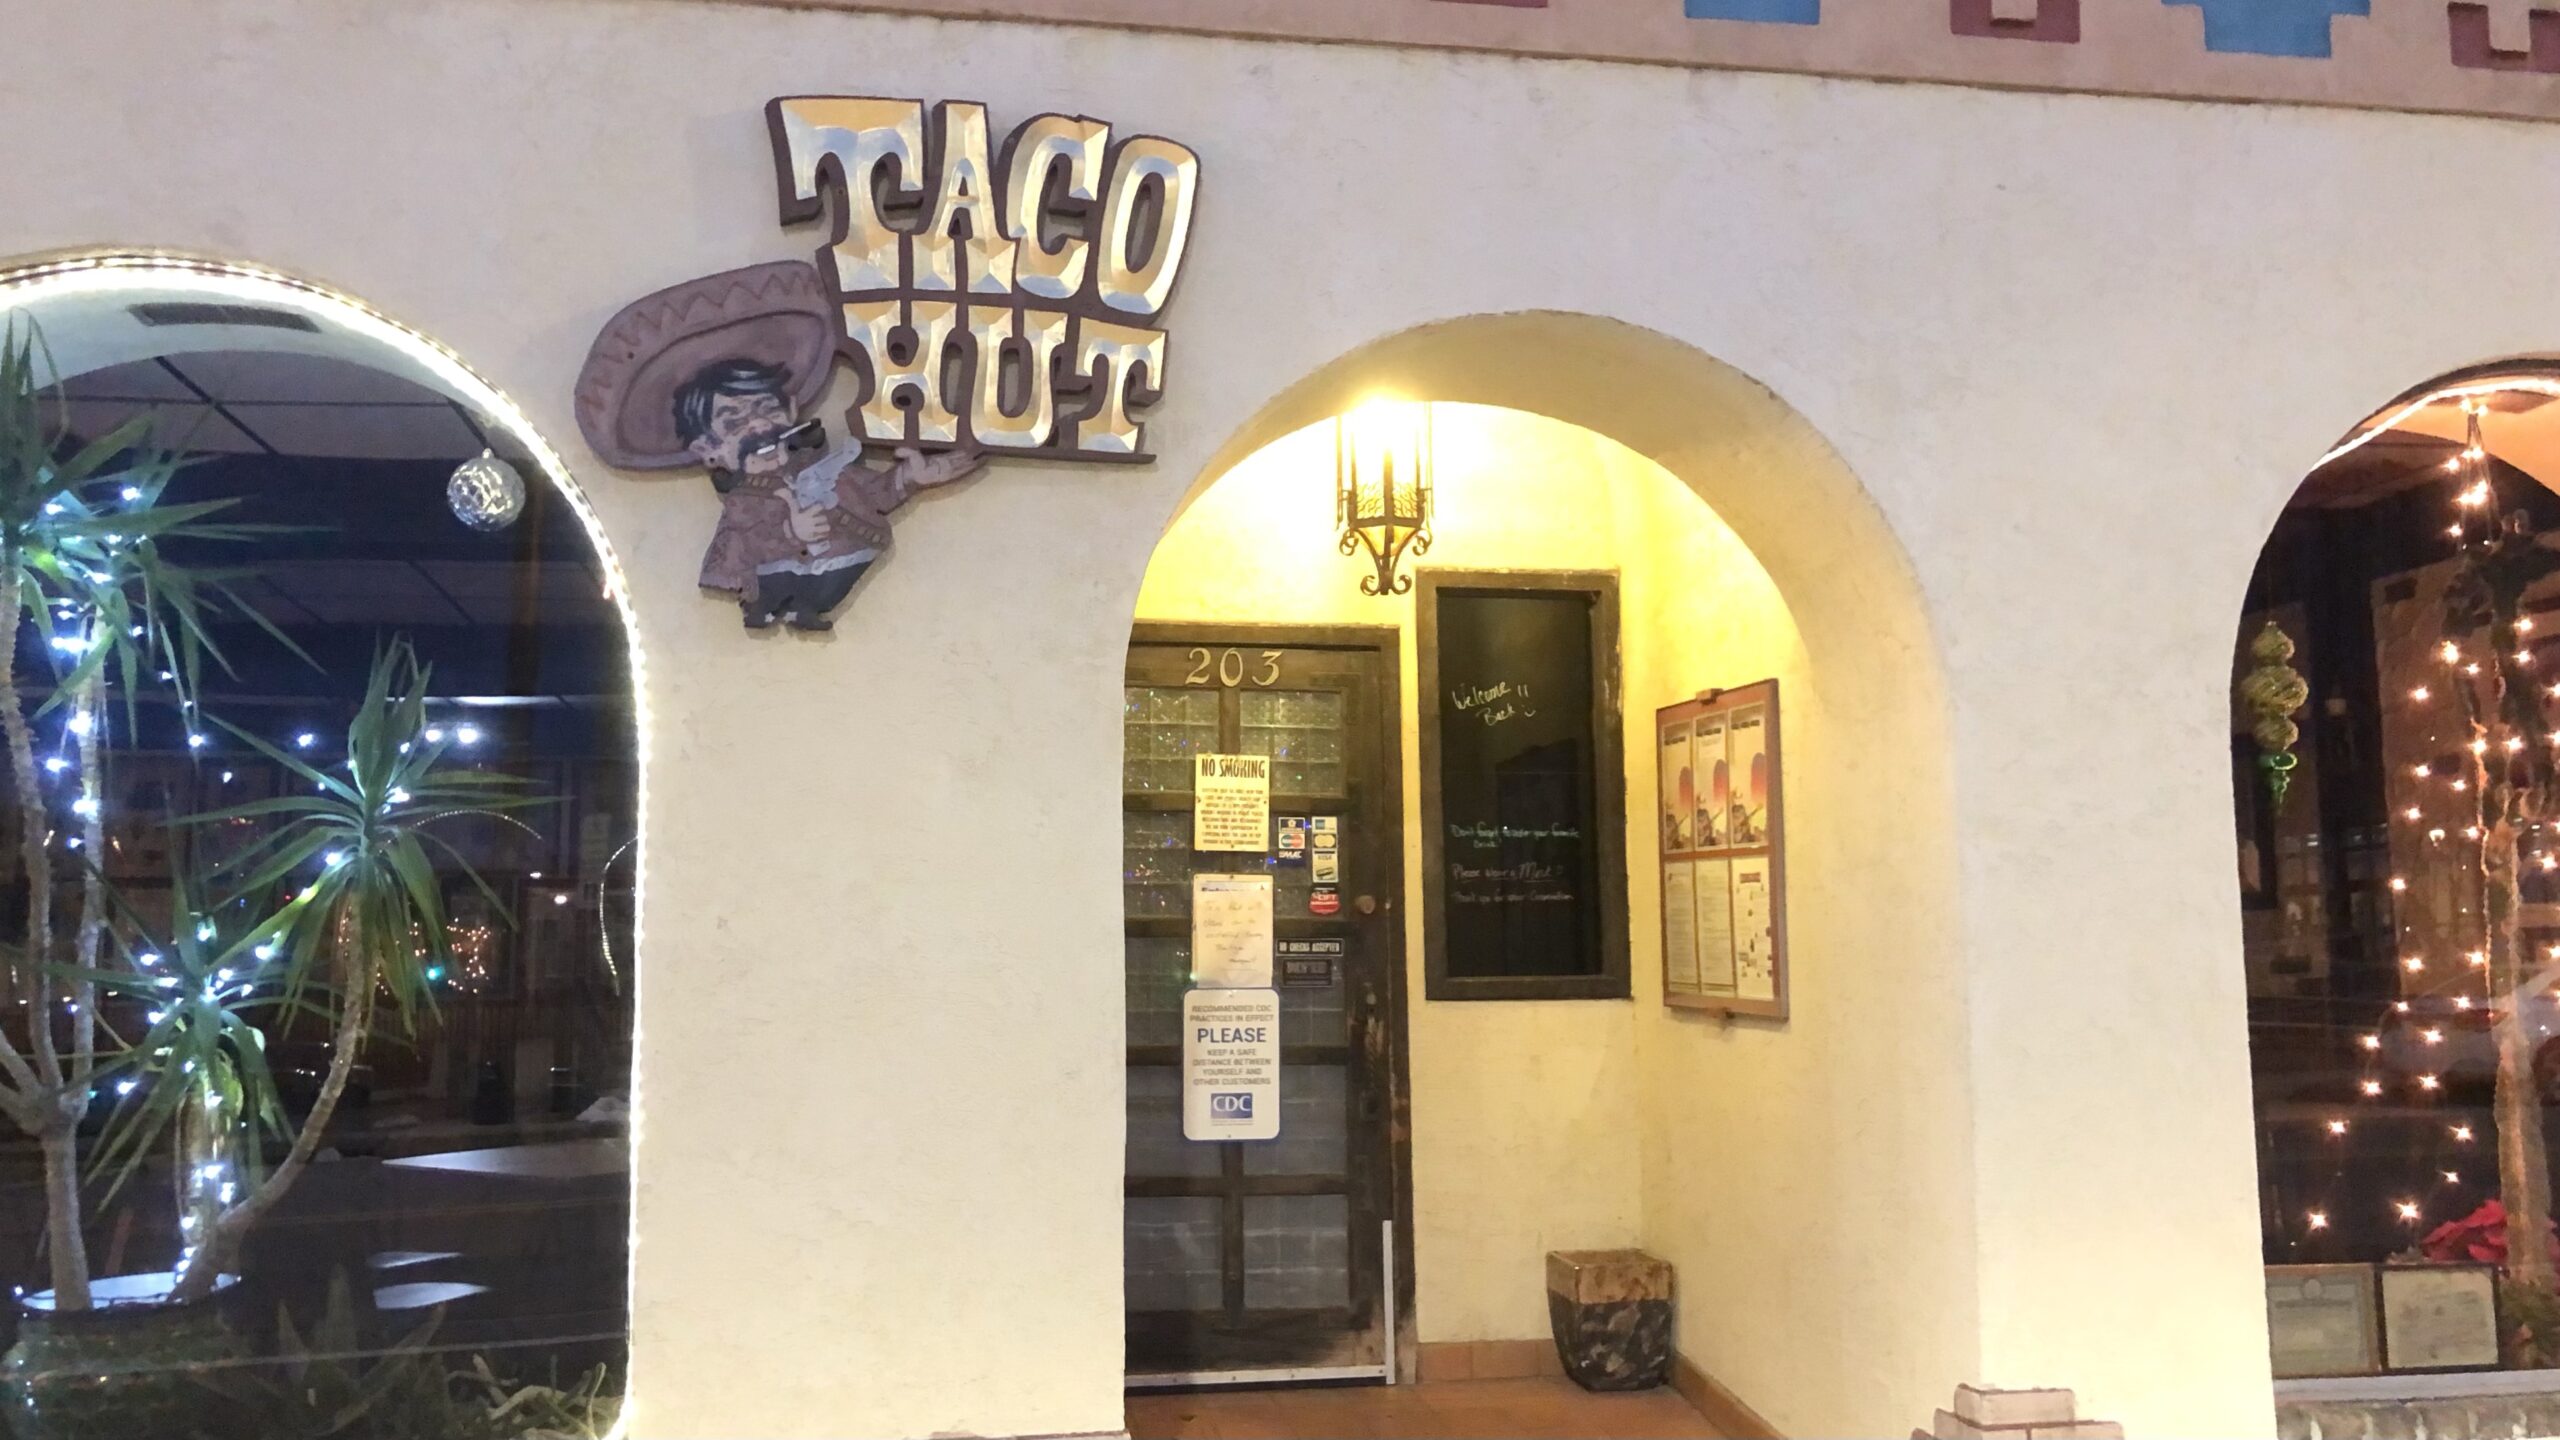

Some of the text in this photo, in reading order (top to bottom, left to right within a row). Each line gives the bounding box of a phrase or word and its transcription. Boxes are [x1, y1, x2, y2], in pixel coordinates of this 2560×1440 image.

[770, 96, 1200, 317] TACO
[840, 299, 1169, 453] HUT
[1185, 647, 1283, 688] 203
[1452, 681, 1511, 710] Welcome
[1201, 757, 1266, 779] NO SMOKING
[1191, 1004, 1272, 1013] RECOMMENDED CDC
[1189, 1014, 1274, 1023] PRACTICES IN EFFECT
[1197, 1027, 1267, 1043] PLEASE
[1207, 1048, 1228, 1056] KEEP
[1236, 1048, 1257, 1056] SAFE
[1192, 1058, 1272, 1067] DISTANCE BETWEEN
[1202, 1068, 1262, 1076] YOURSELF AND
[1192, 1077, 1272, 1086] OTHER CUSTOMERS
[1212, 1095, 1252, 1112] CDC
